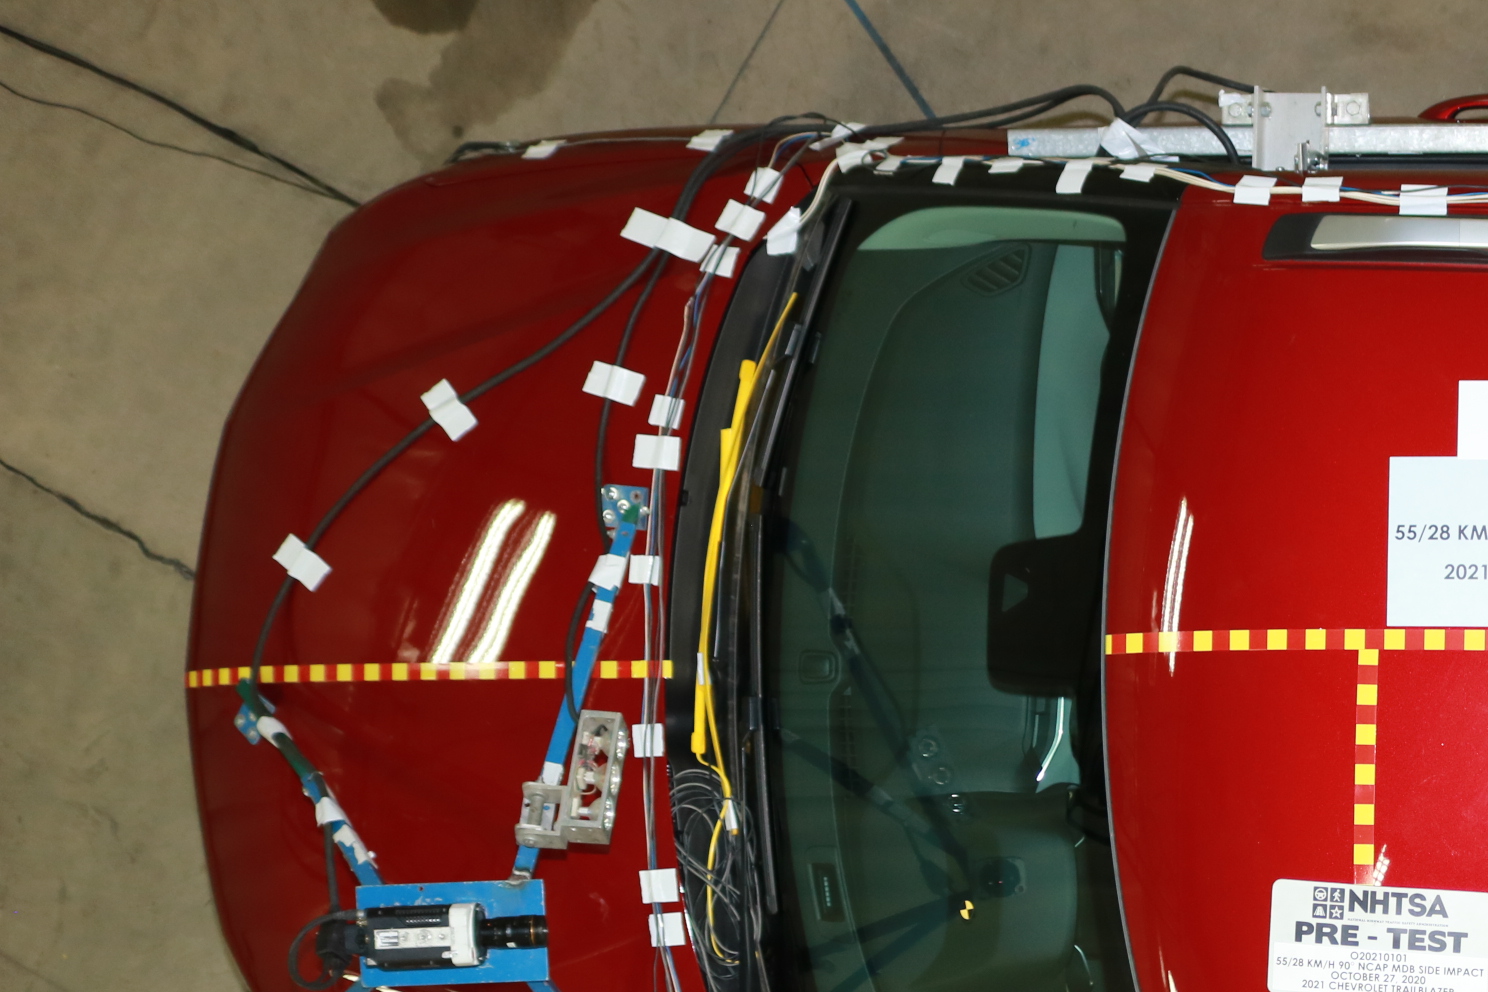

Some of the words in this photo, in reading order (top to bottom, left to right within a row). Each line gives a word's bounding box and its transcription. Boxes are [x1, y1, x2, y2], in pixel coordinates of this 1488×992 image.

[1394, 524, 1451, 543] 55/28
[1444, 564, 1488, 580] 2021
[1348, 888, 1449, 919] NHTSA
[1294, 921, 1360, 947] PRE
[1386, 927, 1469, 954] TEST
[1276, 956, 1304, 967] 55/28
[1307, 959, 1335, 970] KM/H
[1358, 962, 1389, 972] NCAP
[1391, 964, 1415, 974] MDB
[1418, 965, 1440, 975] SIDE
[1443, 967, 1484, 977] IMPACT
[1302, 979, 1324, 989] 2021
[1329, 981, 1388, 992] CHEVROLET
[1331, 971, 1380, 982] OCTOBER
[1383, 974, 1398, 984] 27,
[1401, 974, 1426, 985] 2020
